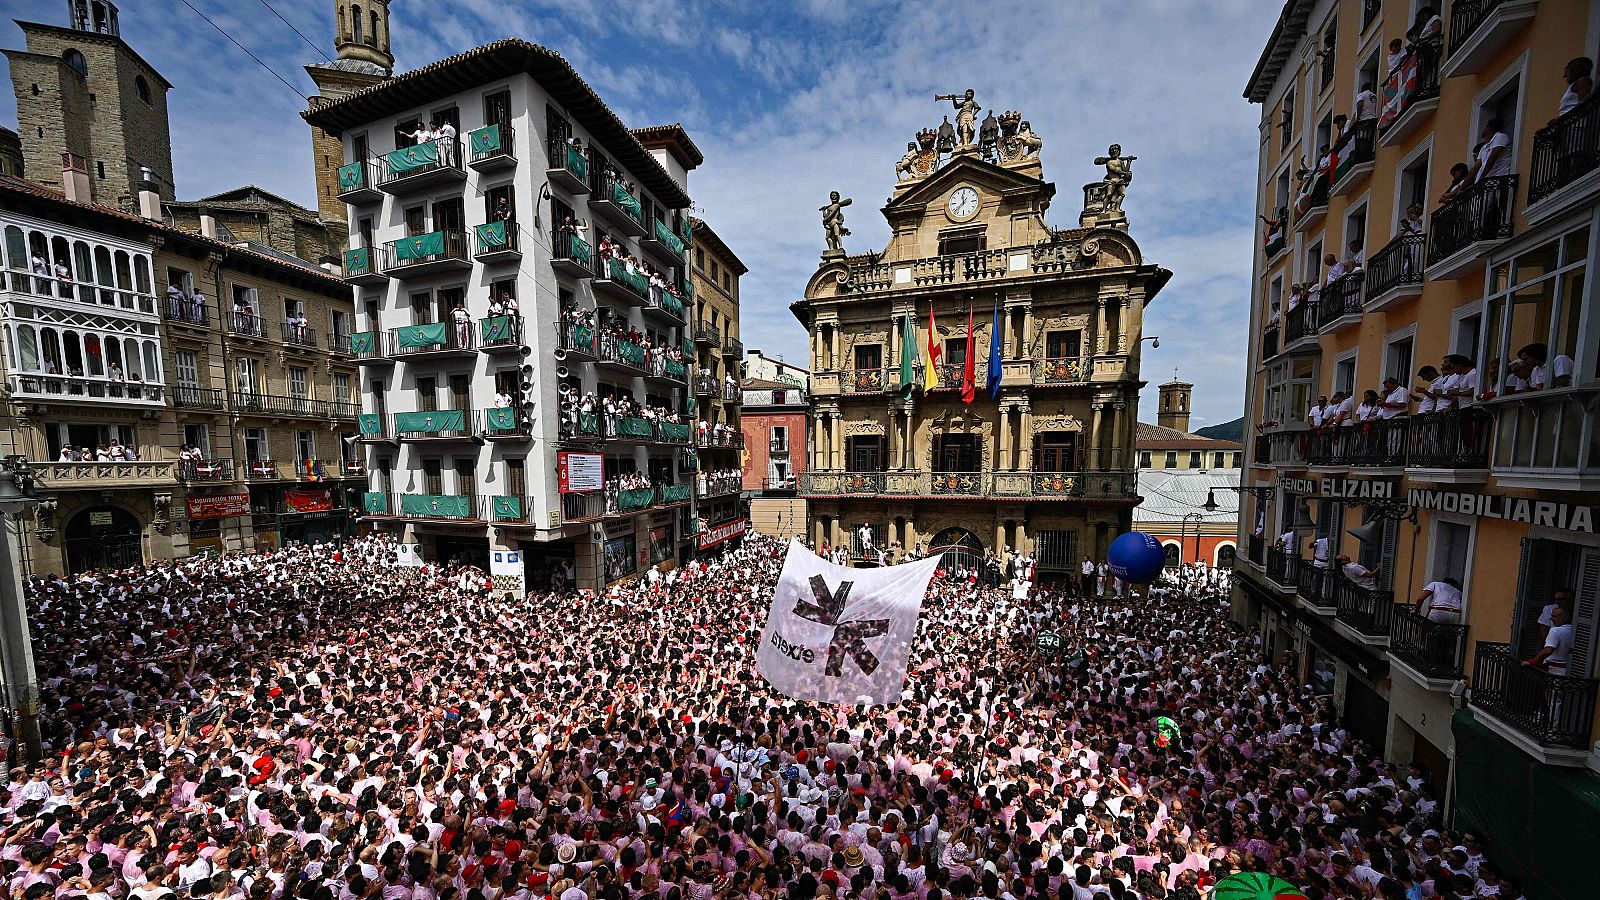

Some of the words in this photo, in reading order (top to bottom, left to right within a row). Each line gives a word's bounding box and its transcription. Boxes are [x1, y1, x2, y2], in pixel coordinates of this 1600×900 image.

[1274, 477, 1314, 493] AGENCIA
[1320, 477, 1393, 499] ELIZARI
[1406, 488, 1594, 533] INMOBILIARIA
[1038, 636, 1060, 647] PAZ
[1420, 713, 1426, 727] 2
